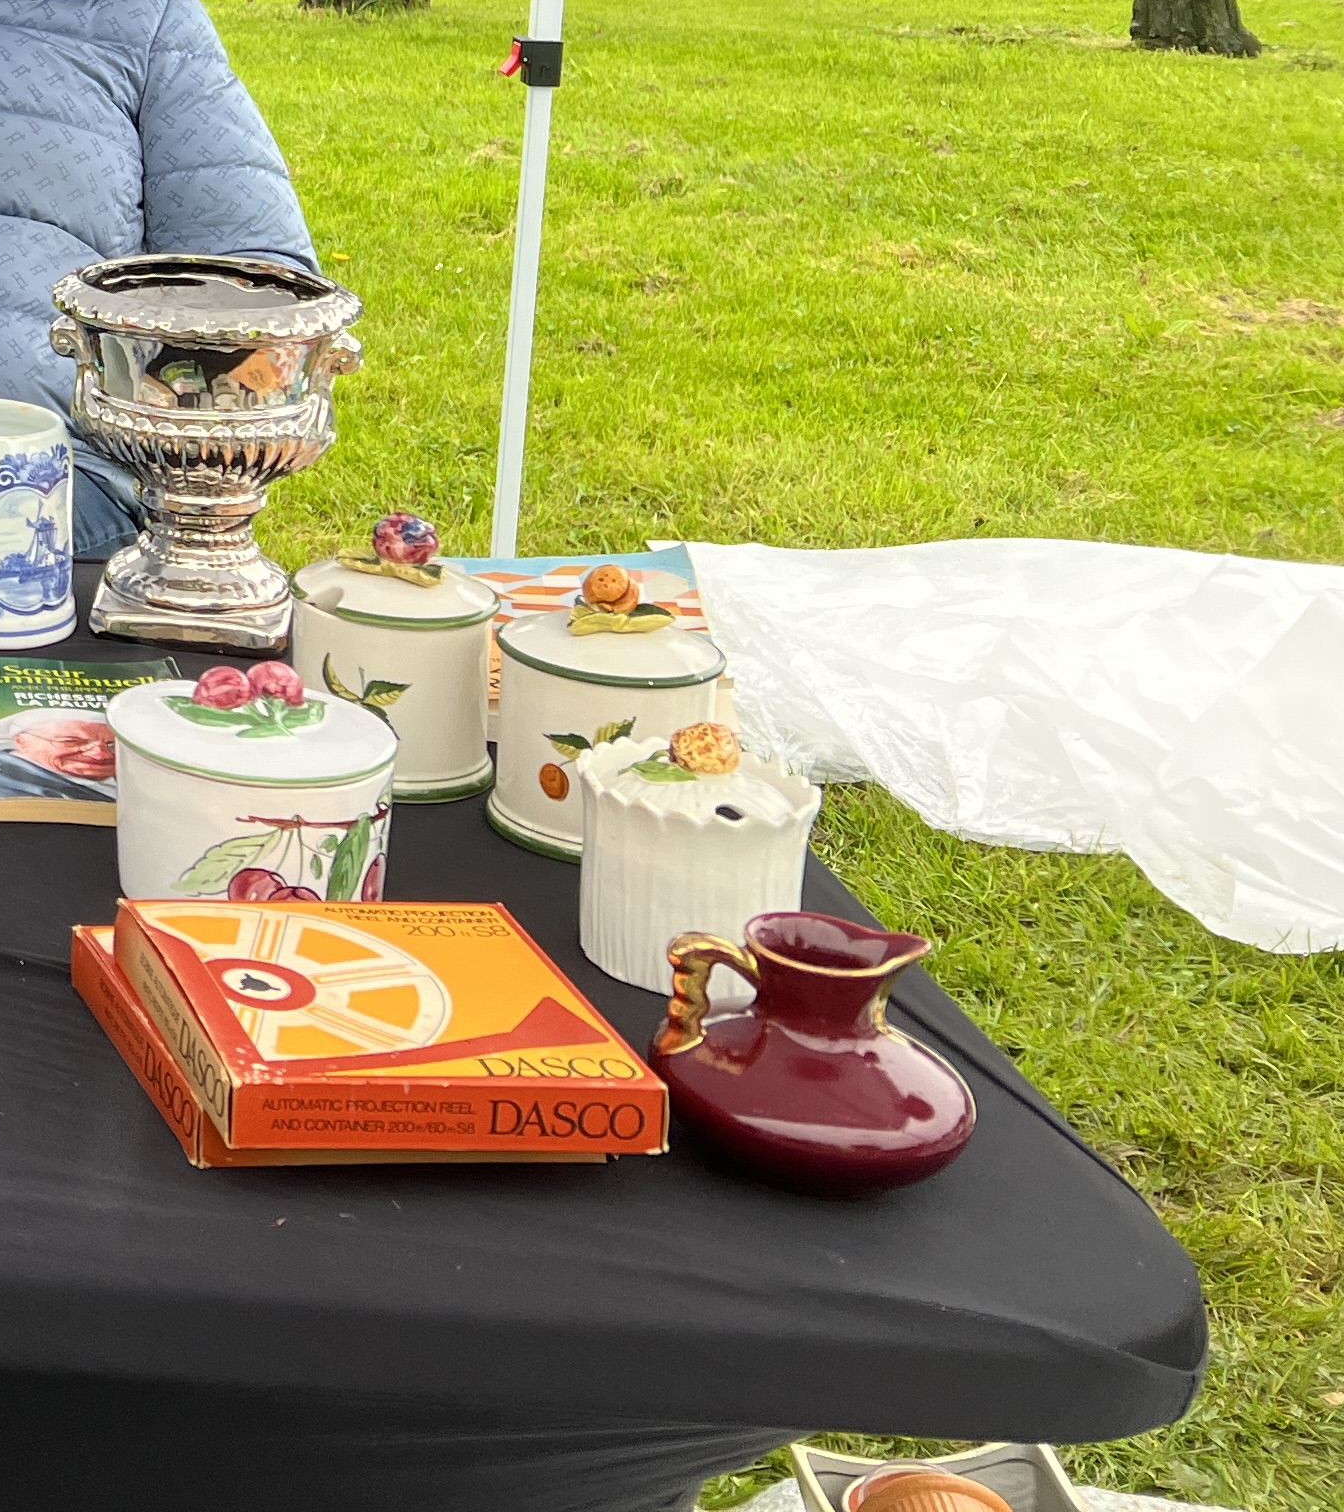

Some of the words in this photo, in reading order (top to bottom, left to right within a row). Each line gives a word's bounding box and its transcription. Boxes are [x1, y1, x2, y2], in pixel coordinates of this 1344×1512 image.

[14, 691, 109, 703] RICHESSE
[16, 699, 40, 708] LA
[47, 700, 110, 710] PAUV
[400, 924, 457, 938] 200
[472, 925, 513, 938] S8
[178, 1018, 225, 1118] DASCO
[474, 1057, 638, 1080] DASCO
[144, 1042, 194, 1138] DASCO
[261, 1098, 345, 1113] AUTOMATIC
[345, 1100, 437, 1115] PROJECTION
[438, 1101, 477, 1116] REEL
[270, 1118, 303, 1132] AND
[304, 1119, 386, 1134] CONTAINER
[487, 1098, 647, 1141] DASCO
